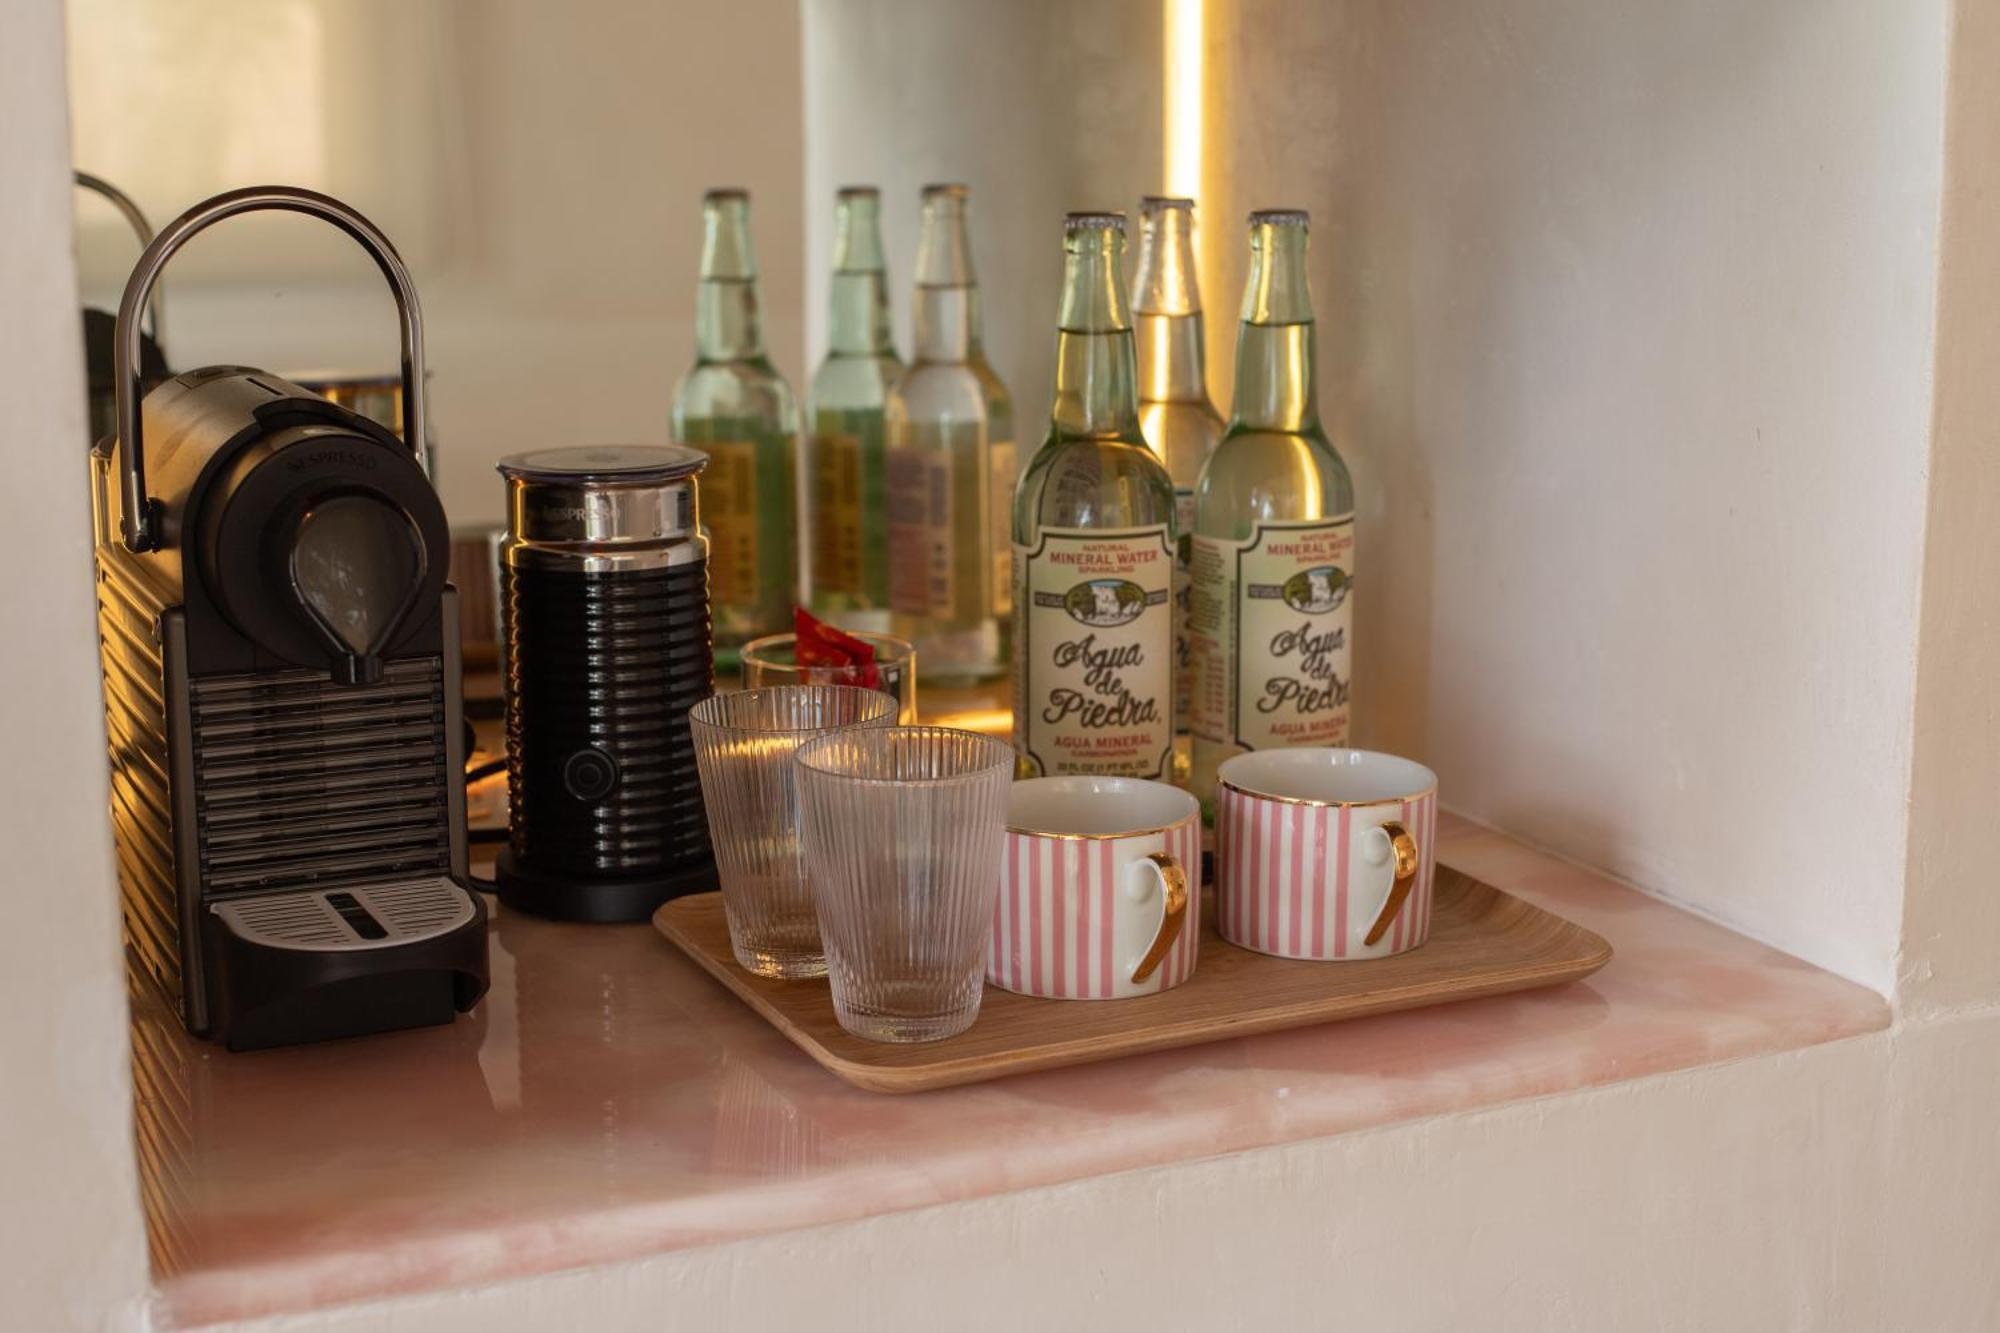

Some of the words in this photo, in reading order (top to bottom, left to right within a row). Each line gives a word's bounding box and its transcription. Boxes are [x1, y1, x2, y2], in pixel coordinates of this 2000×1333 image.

[1050, 550, 1113, 564] MINERAL
[1116, 549, 1159, 564] WATER
[1266, 542, 1327, 556] MINERAL
[1270, 621, 1346, 674] Agua
[1053, 633, 1145, 686] Agua
[1309, 655, 1332, 681] de
[1095, 669, 1124, 696] de
[1269, 722, 1305, 736] AGUA
[1054, 735, 1091, 749] AGUA
[1095, 733, 1153, 748] MINERAL
